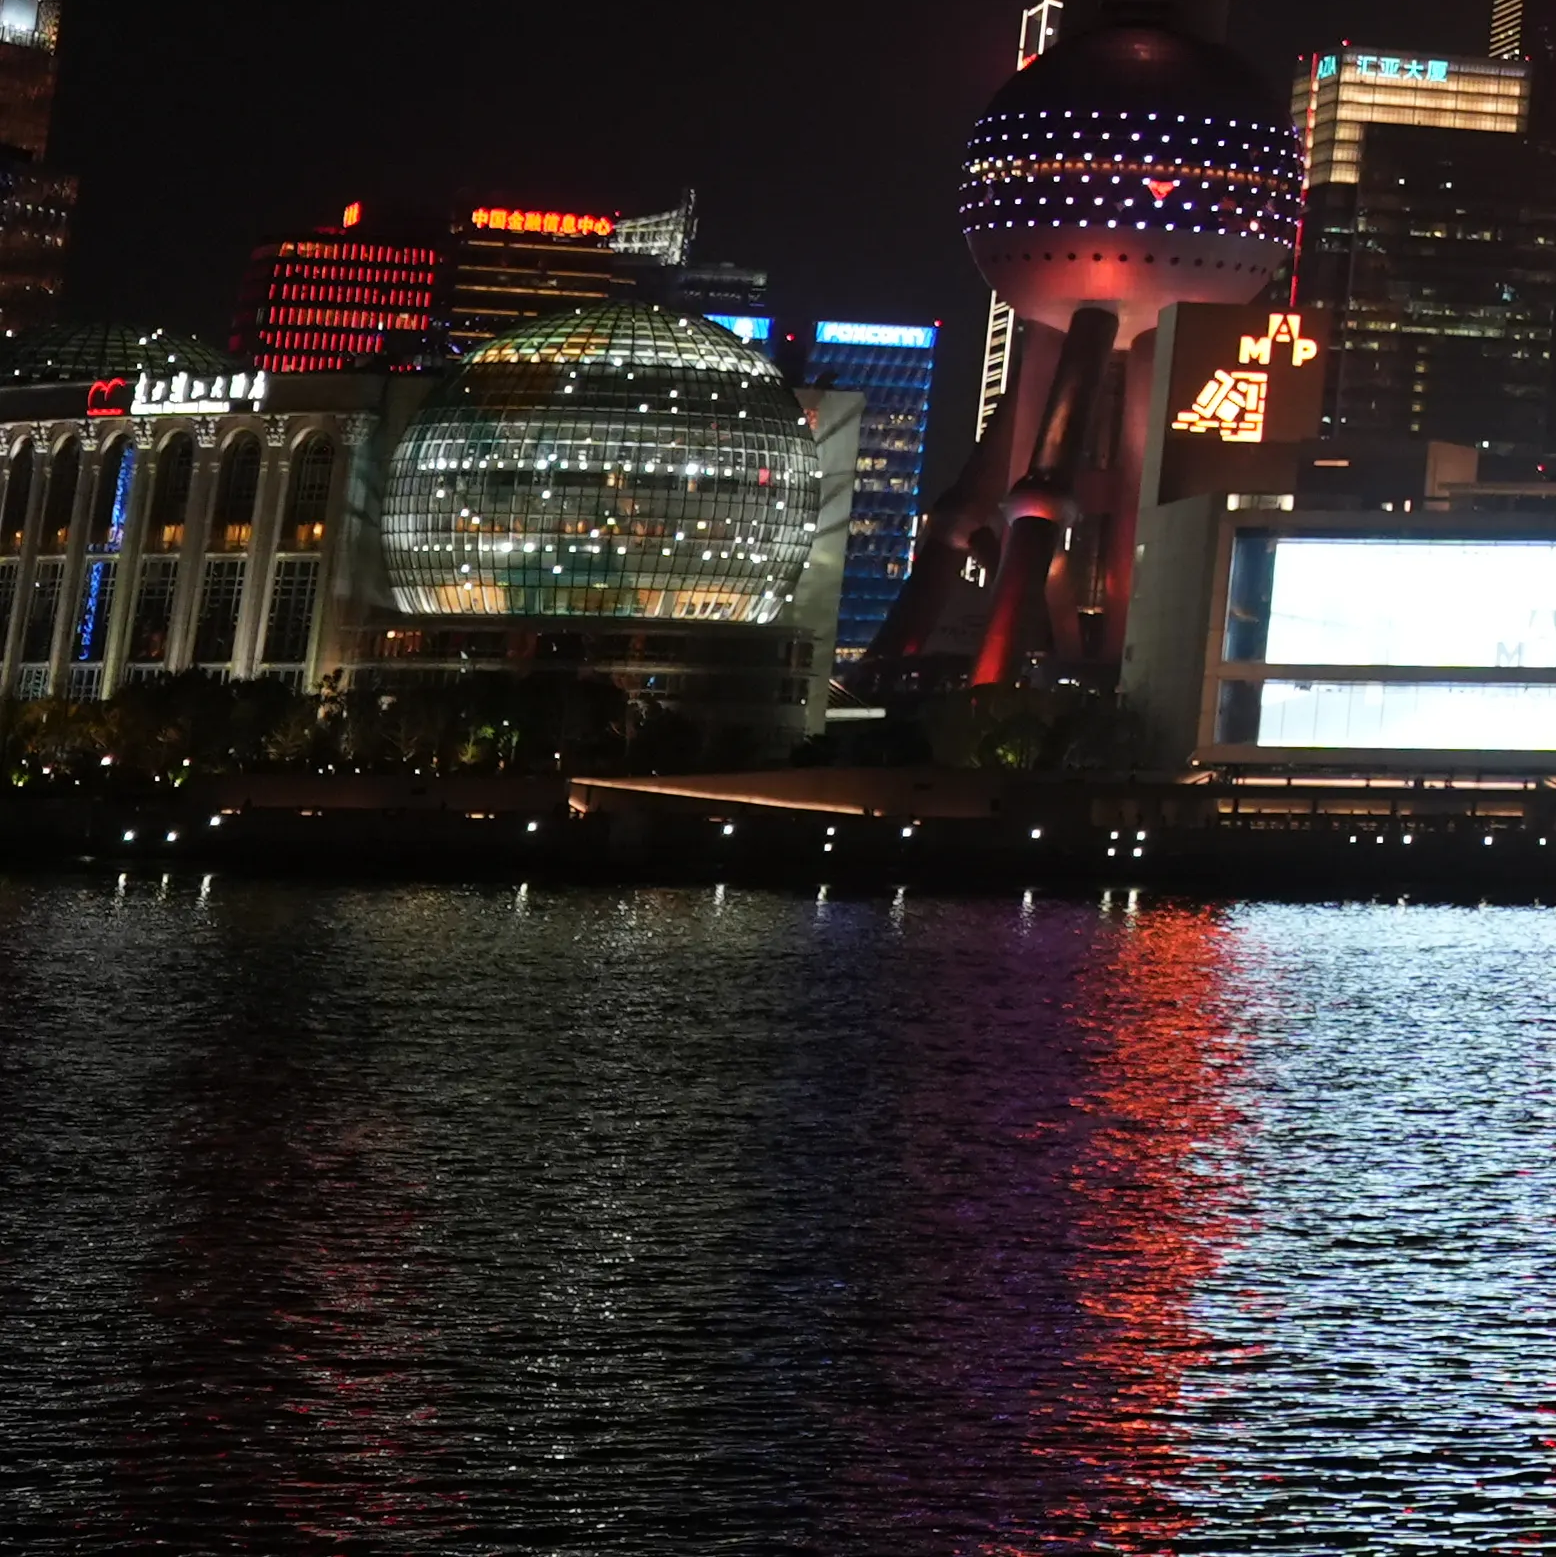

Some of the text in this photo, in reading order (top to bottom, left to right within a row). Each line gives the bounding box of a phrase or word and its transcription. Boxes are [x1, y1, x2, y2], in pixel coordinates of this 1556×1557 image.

[1356, 55, 1449, 83] 汇亚大厦
[471, 207, 614, 237] 中国金融信息中心
[1238, 313, 1318, 367] MAP
